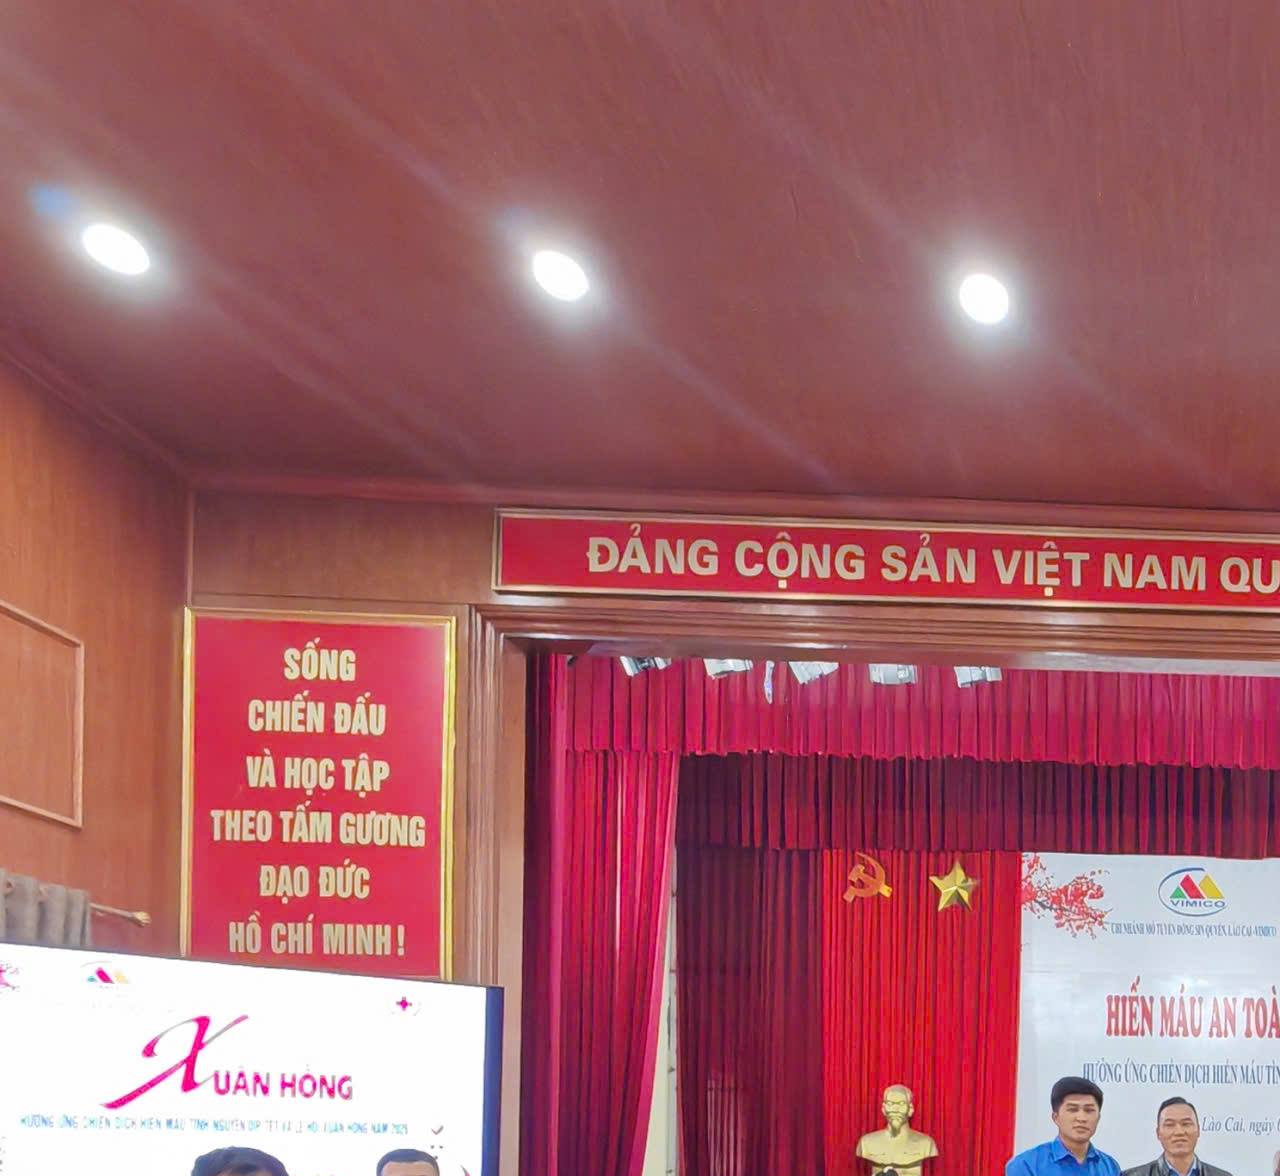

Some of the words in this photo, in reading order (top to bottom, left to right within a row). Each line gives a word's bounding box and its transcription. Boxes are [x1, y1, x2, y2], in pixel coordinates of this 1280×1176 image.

[587, 524, 718, 576] ĐẢNG
[734, 531, 866, 589] CỘNG
[881, 534, 976, 584] SẢN
[992, 541, 1089, 597] VIỆT
[1102, 552, 1207, 591] NAM
[284, 637, 356, 681] SỐNG
[248, 690, 324, 733] CHIẾN
[334, 692, 386, 735] ĐẤU
[246, 748, 276, 788] VÀ
[284, 757, 335, 796] HỌC
[342, 753, 390, 798] TẬP
[210, 810, 272, 842] THEO
[280, 801, 332, 843] TẤM
[339, 811, 426, 847] GƯƠNG
[260, 865, 309, 904] ĐẠO
[319, 858, 370, 899] ĐỨC
[1170, 900, 1225, 908] VIMICO
[229, 911, 261, 954] HỒ
[271, 913, 314, 954] CHÍ
[323, 923, 391, 955] MINH
[1106, 975, 1154, 1037] HIẾN
[1160, 984, 1203, 1038] MÁU
[1208, 997, 1237, 1038] AN
[1124, 1058, 1148, 1084] ỨNG
[1184, 1063, 1210, 1088] DỊCH
[1240, 1060, 1265, 1085] MÁU
[1202, 1117, 1221, 1132] Lào
[1249, 1117, 1275, 1136] ngày
